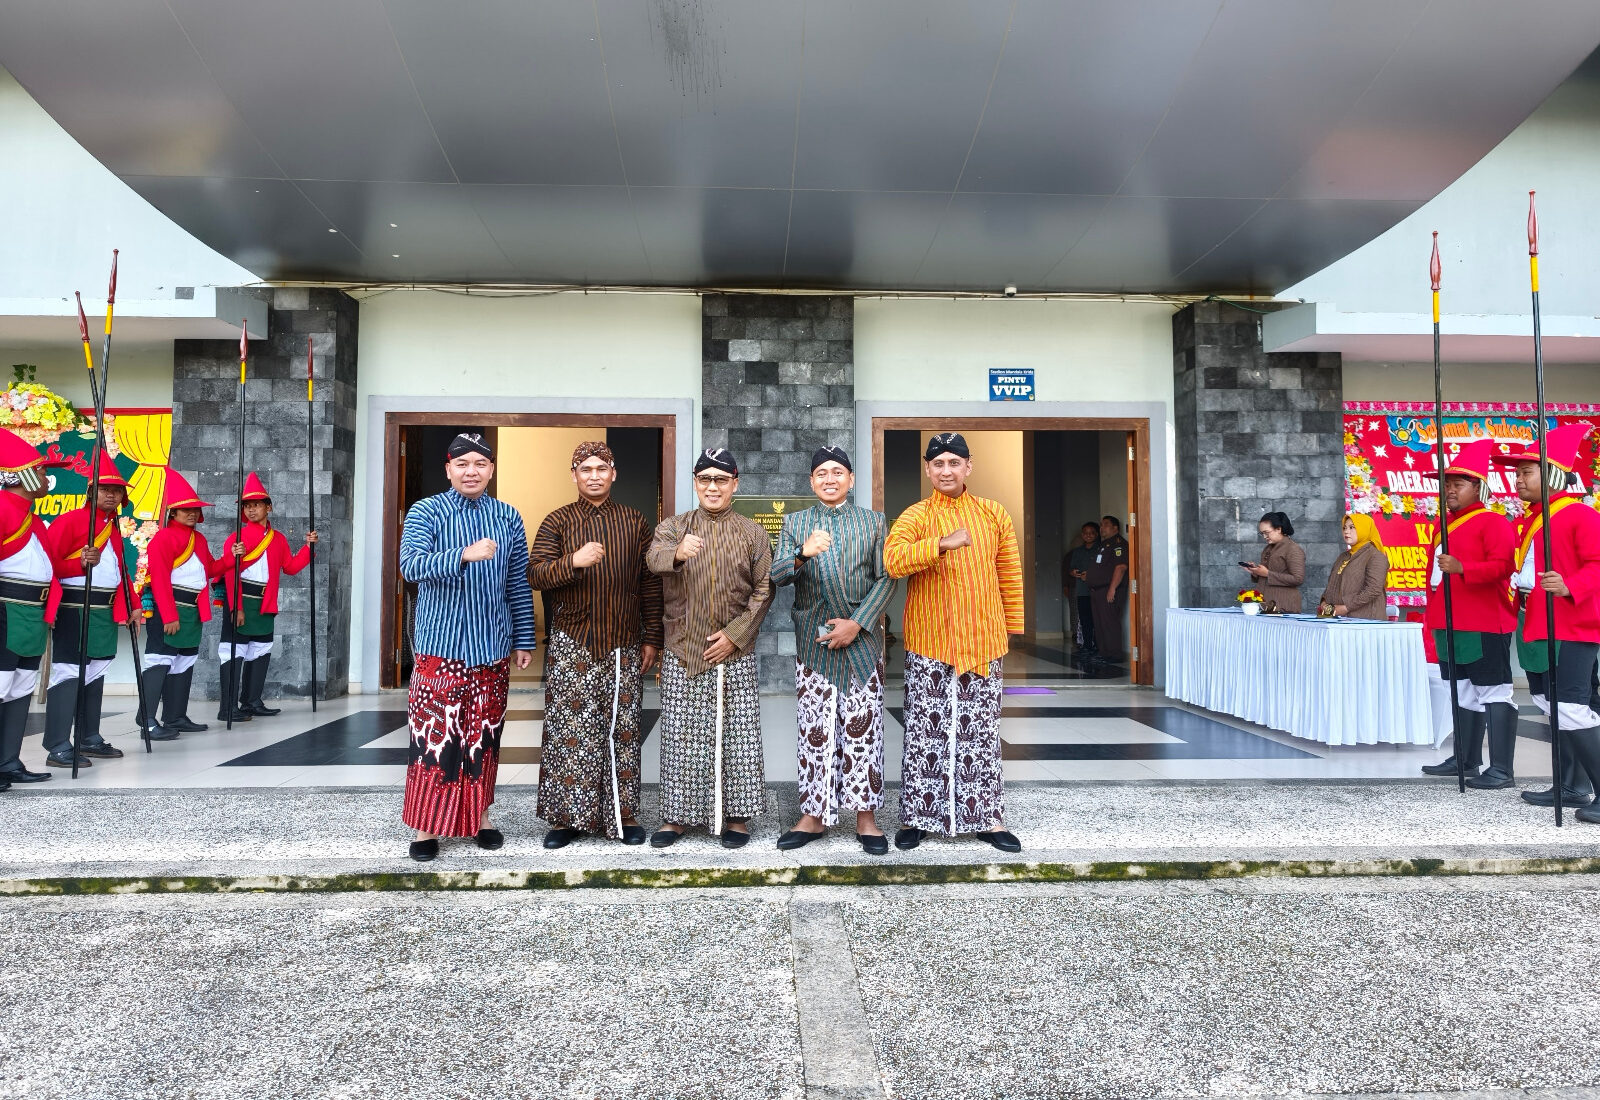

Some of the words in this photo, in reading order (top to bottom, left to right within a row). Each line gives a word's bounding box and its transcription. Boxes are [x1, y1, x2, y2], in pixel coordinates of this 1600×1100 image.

[997, 376, 1027, 384] PINTU
[992, 385, 1032, 396] VVIP
[1473, 422, 1484, 437] &
[1485, 417, 1533, 441] Sukses
